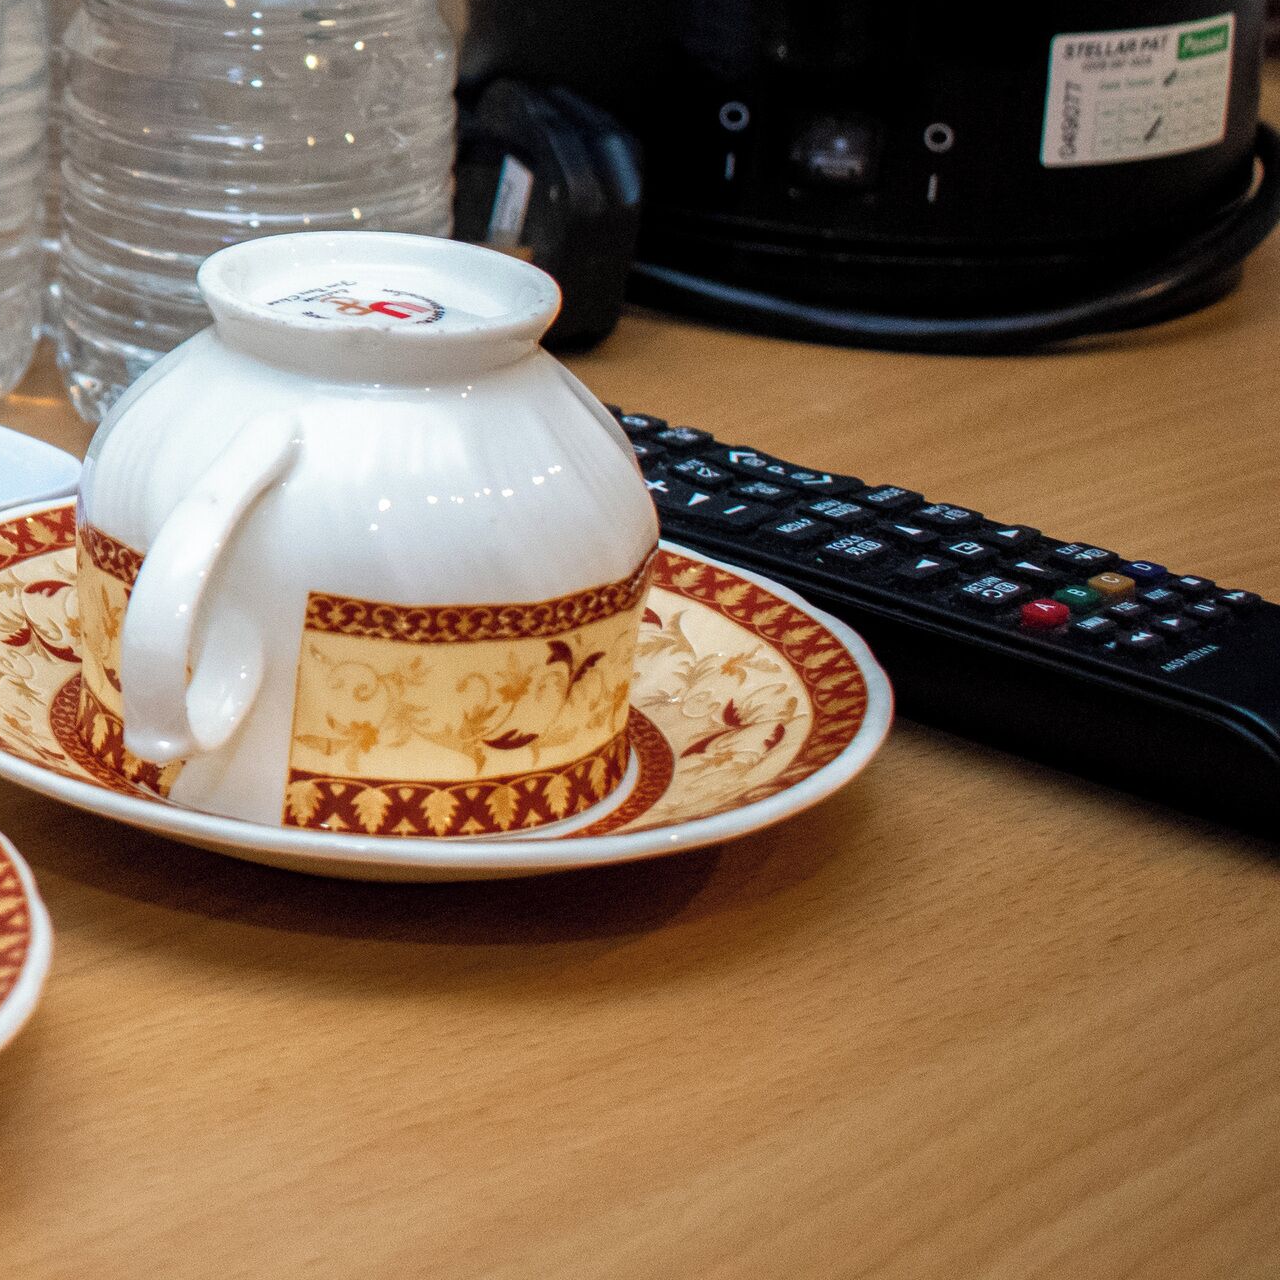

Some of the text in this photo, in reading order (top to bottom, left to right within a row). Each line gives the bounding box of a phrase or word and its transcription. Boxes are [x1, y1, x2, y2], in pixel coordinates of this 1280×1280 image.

[867, 487, 906, 503] GUIDE
[824, 534, 866, 551] TOOLS
[1055, 543, 1085, 555] EXIT
[1132, 562, 1152, 571] D
[961, 575, 1003, 594] RETURN
[1100, 574, 1120, 584] C
[1067, 588, 1087, 597] B
[1034, 602, 1056, 612] A
